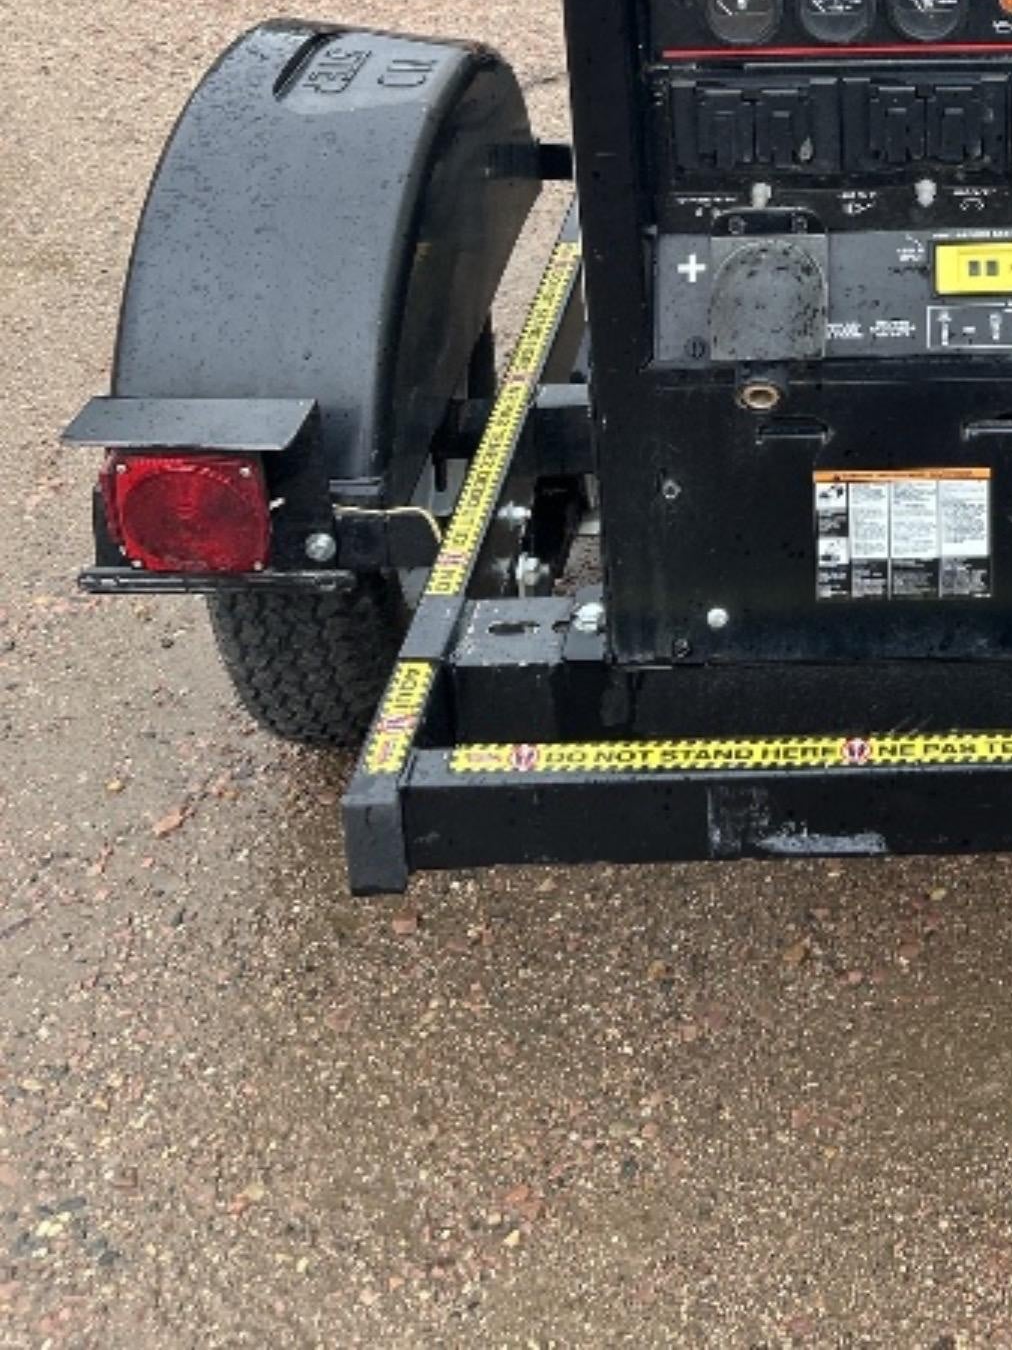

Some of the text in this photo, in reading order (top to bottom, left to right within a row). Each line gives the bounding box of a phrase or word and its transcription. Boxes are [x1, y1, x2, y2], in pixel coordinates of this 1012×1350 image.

[545, 749, 588, 763] DO
[594, 749, 654, 763] NOT
[660, 747, 753, 761] STAND
